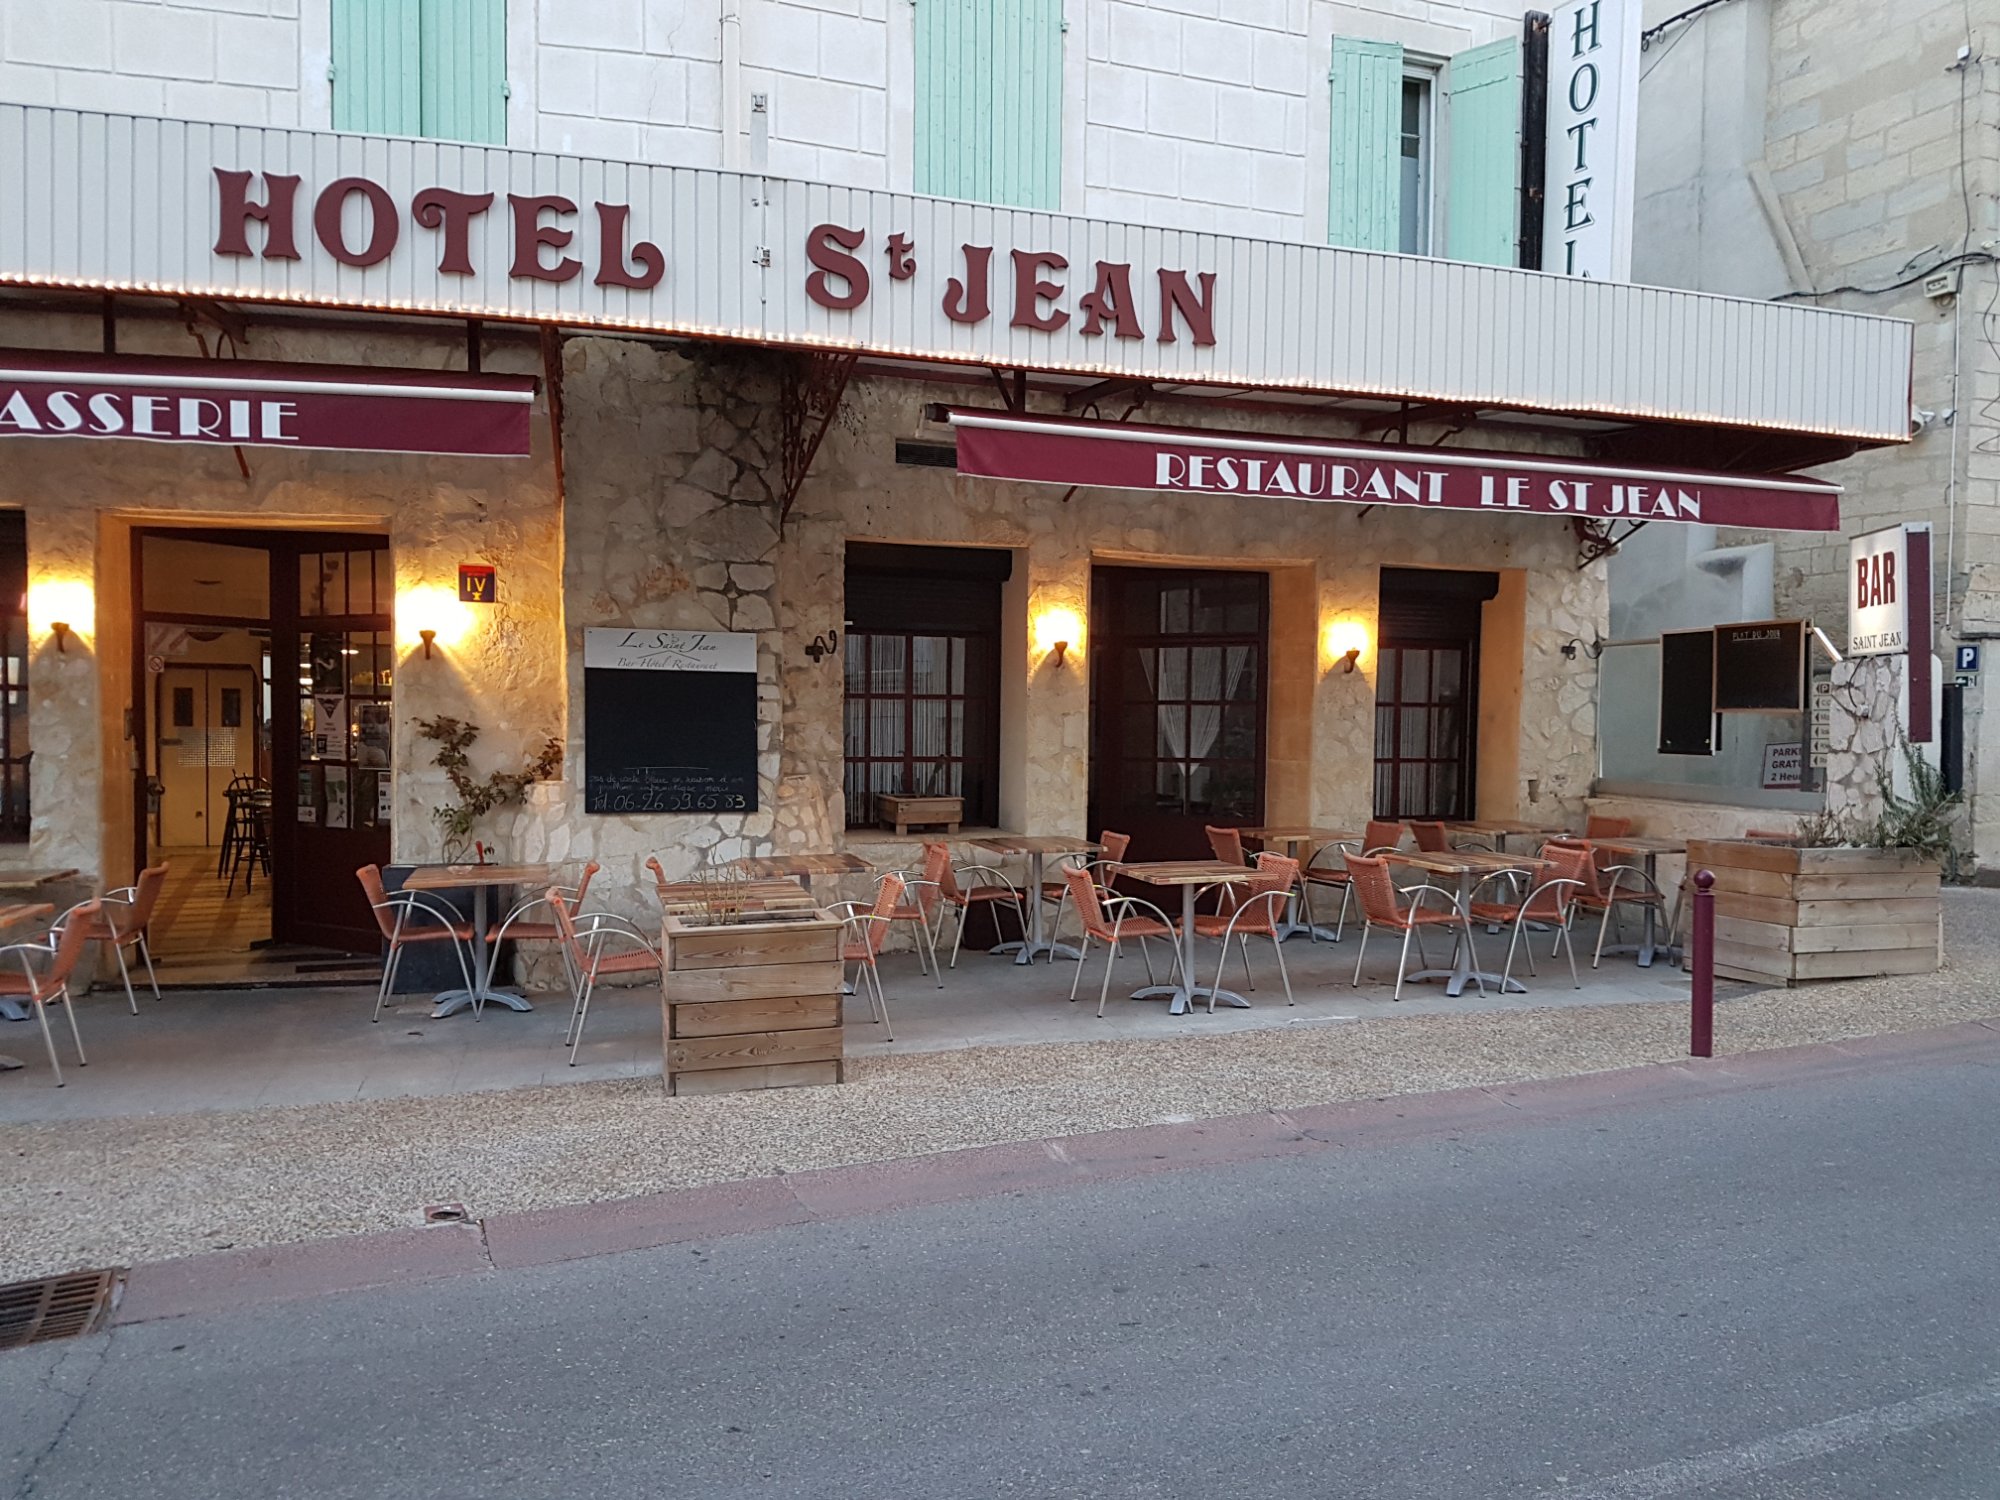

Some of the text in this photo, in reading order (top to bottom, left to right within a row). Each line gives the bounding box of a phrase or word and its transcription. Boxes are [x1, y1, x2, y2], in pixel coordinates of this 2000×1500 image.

[212, 166, 1218, 347] HOTEL St JEAN
[1154, 452, 1701, 520] RESTAURANT LE ST JEAN
[466, 577, 487, 592] IV
[1857, 551, 1896, 609] BAR
[617, 632, 717, 653] Le Saint Jean
[1853, 632, 1902, 650] SAINT JEAN
[617, 657, 635, 667] Bar
[672, 659, 718, 671] Restaurant
[1962, 648, 1974, 668] P
[1770, 772, 1777, 781] 2
